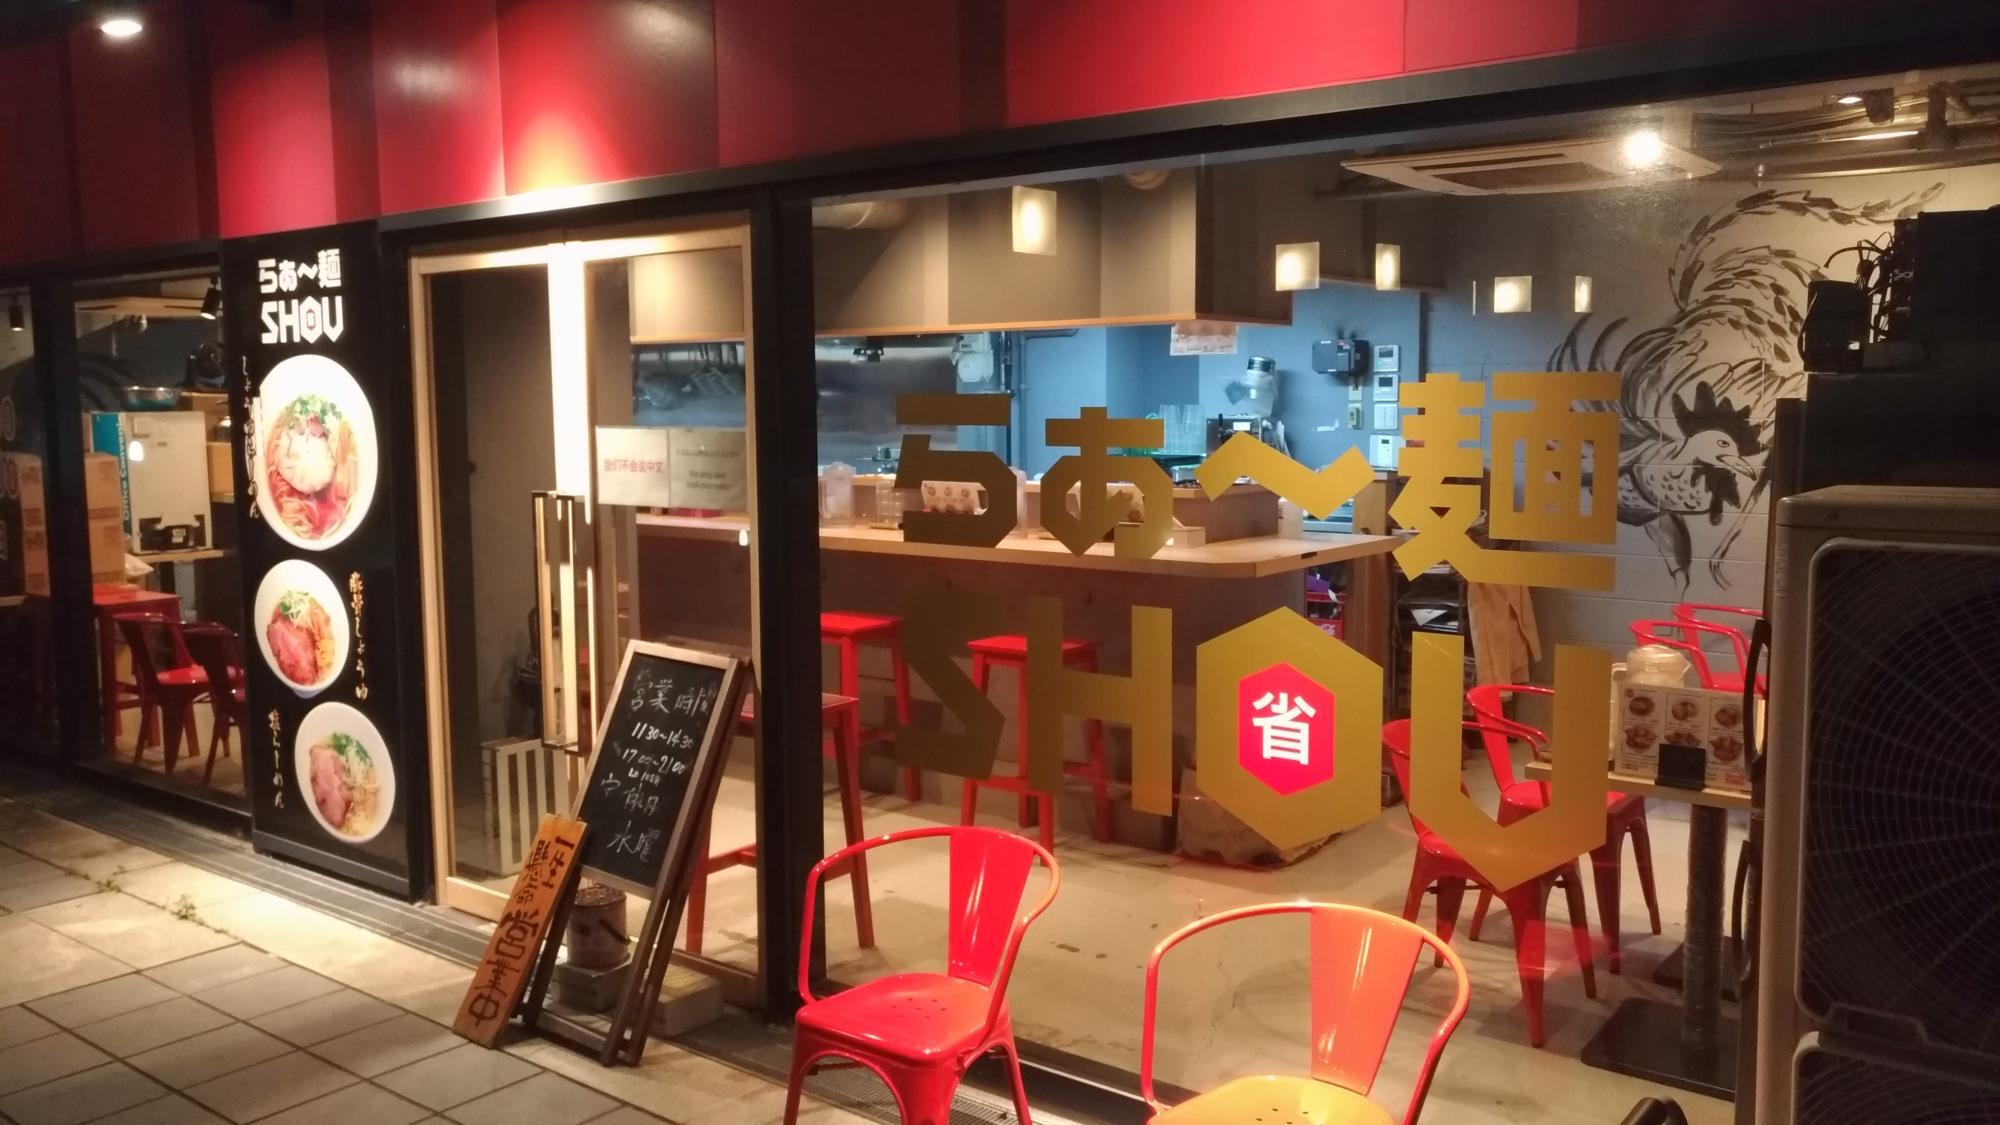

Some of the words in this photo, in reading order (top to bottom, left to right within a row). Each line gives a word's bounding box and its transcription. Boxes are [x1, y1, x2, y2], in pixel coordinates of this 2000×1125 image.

[261, 296, 344, 344] SHOU
[631, 669, 716, 717] 営業時間
[895, 588, 1613, 892] SHOU
[1252, 690, 1317, 766] 省
[606, 820, 661, 862] 水曜
